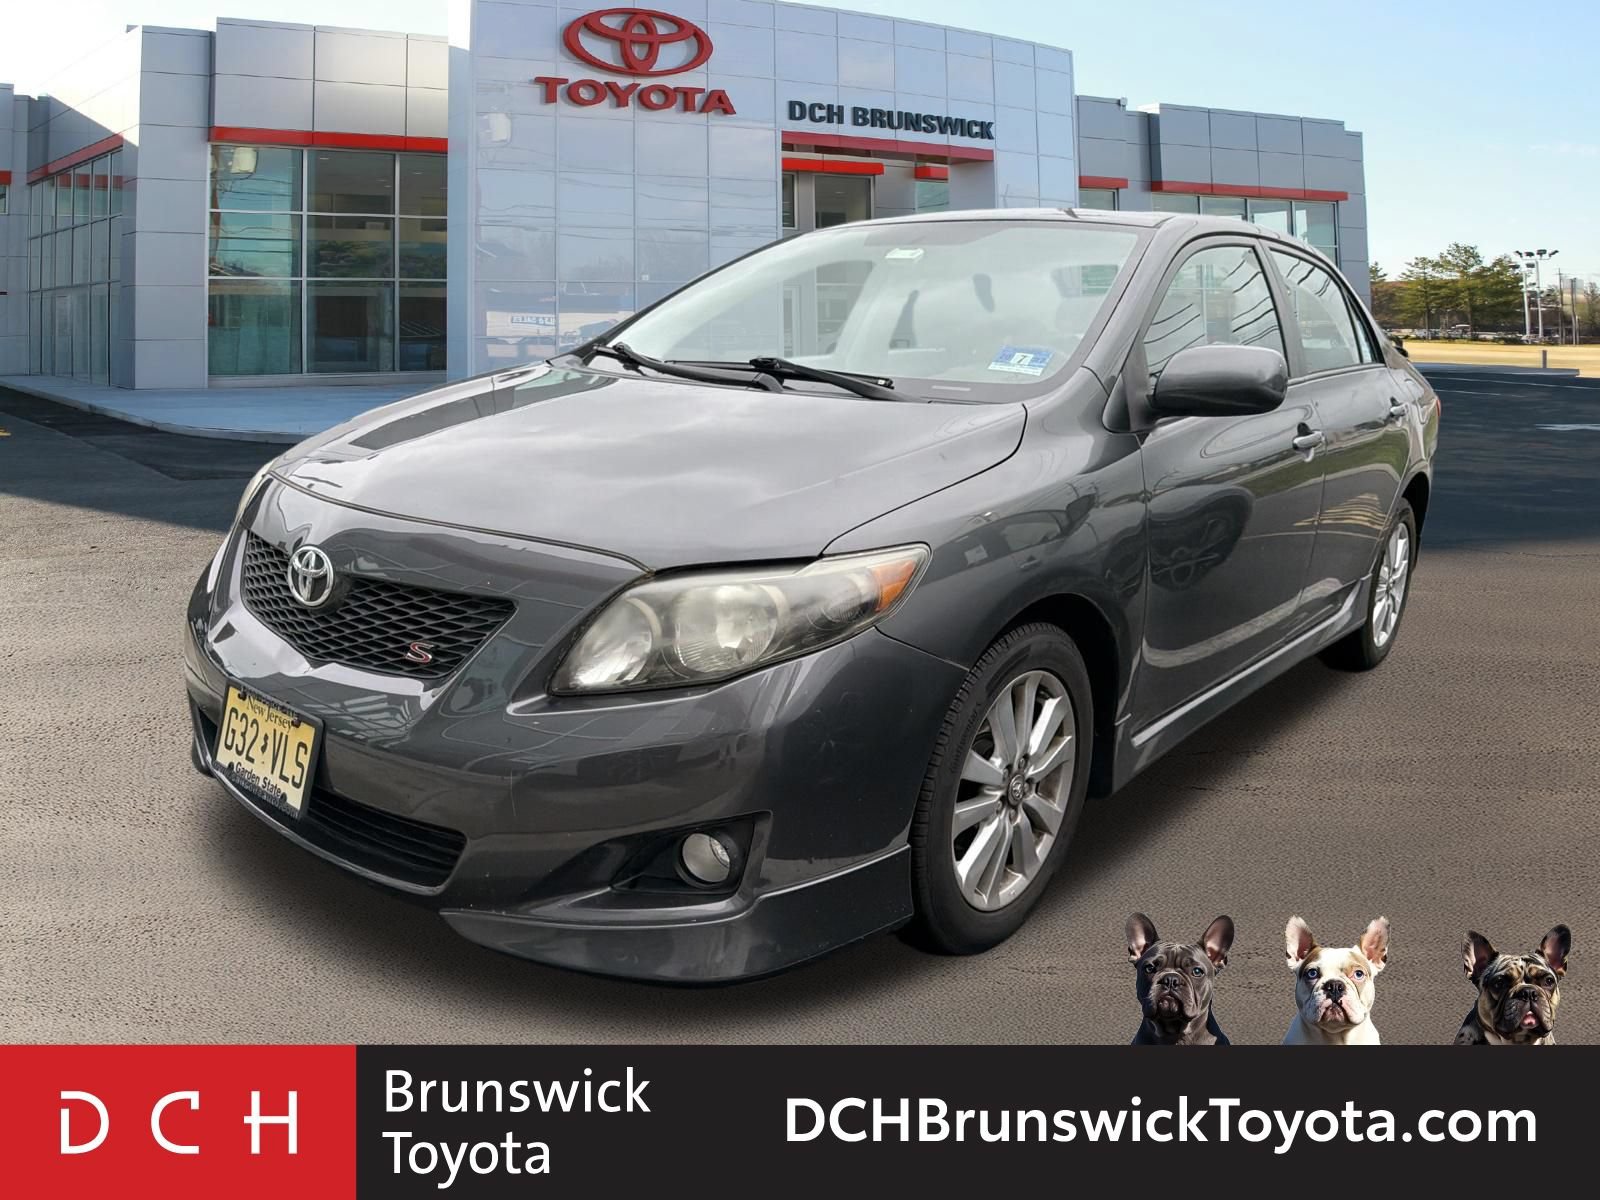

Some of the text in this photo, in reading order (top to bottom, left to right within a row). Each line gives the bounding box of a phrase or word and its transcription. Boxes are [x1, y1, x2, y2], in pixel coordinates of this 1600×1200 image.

[534, 76, 736, 115] TOYOTA
[788, 100, 995, 141] DCH BRUNSWICK
[1016, 354, 1029, 364] 7
[405, 641, 434, 664] S
[246, 694, 267, 717] New
[265, 703, 292, 734] Jersey
[235, 761, 283, 798] Garden State
